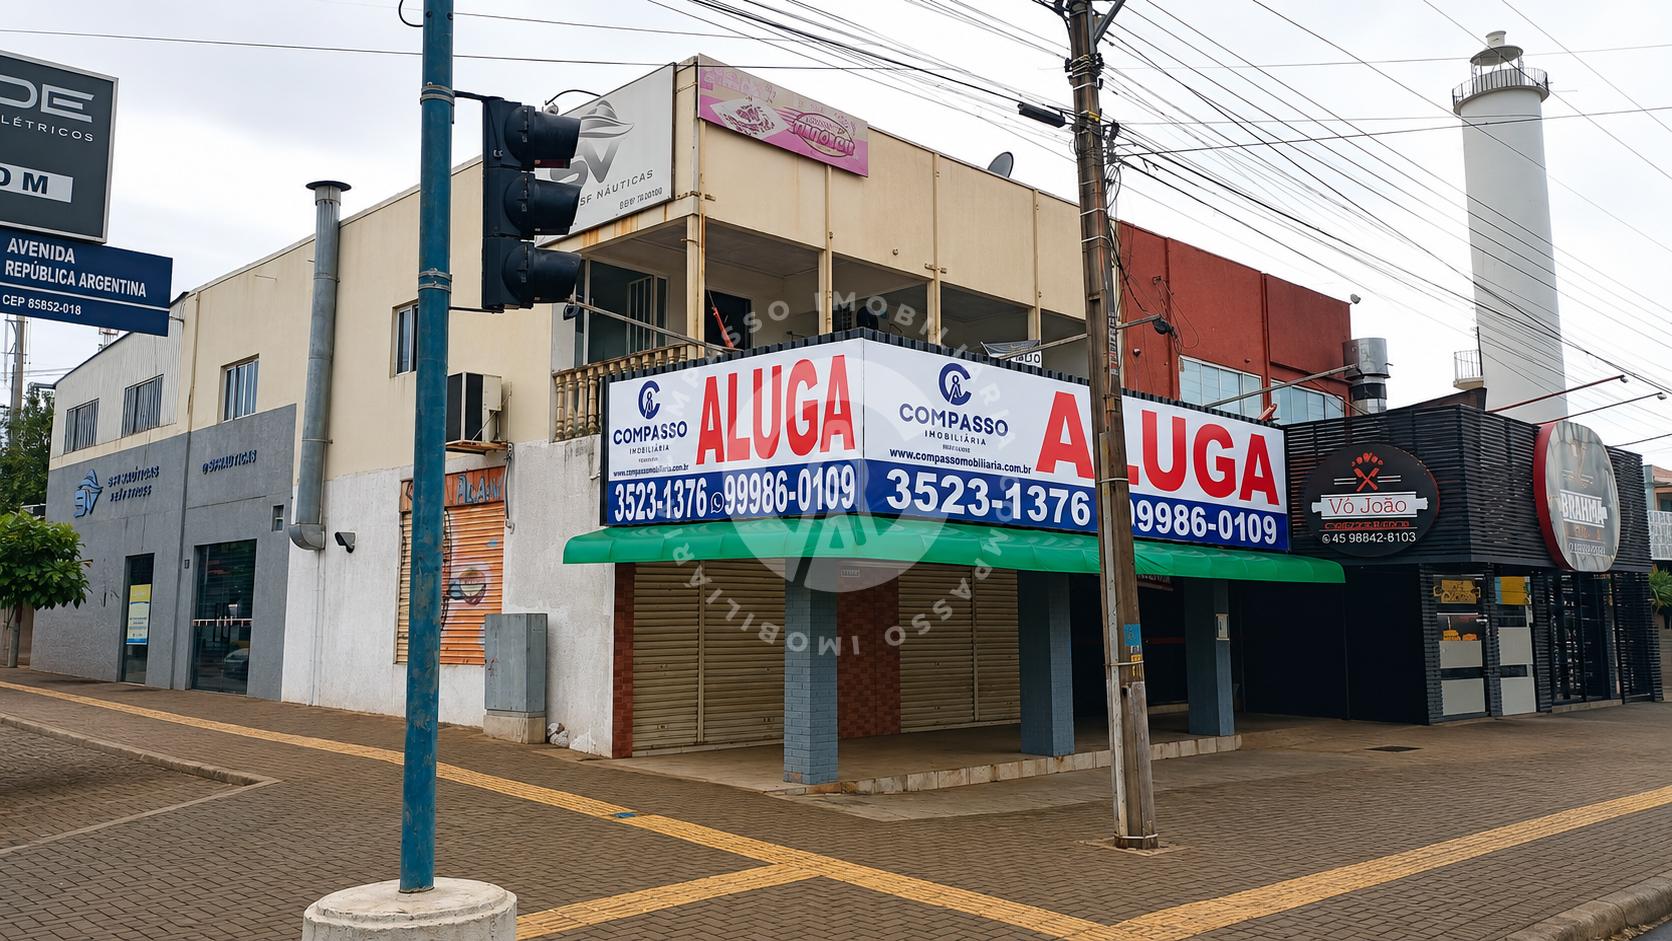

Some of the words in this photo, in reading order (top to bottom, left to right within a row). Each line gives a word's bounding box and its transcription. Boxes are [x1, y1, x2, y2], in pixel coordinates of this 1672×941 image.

[597, 169, 653, 199] NÁUTICAS
[7, 237, 75, 264] AVENIDA
[5, 259, 76, 287] REPÚBLICA
[79, 272, 147, 298] ARGENTINA
[2, 294, 25, 306] CEP
[696, 354, 856, 466] ALUGA
[899, 403, 1008, 437] COMPASSO
[613, 421, 688, 445] COMPASSO
[924, 430, 987, 446] IMOBILIÁRIA
[1035, 391, 1281, 506] AUGA
[615, 477, 708, 522] 3523-1376
[724, 464, 856, 515] 99986-0109
[885, 467, 1092, 527] 3523-1376
[1360, 496, 1407, 514] João
[1332, 533, 1346, 543] 45
